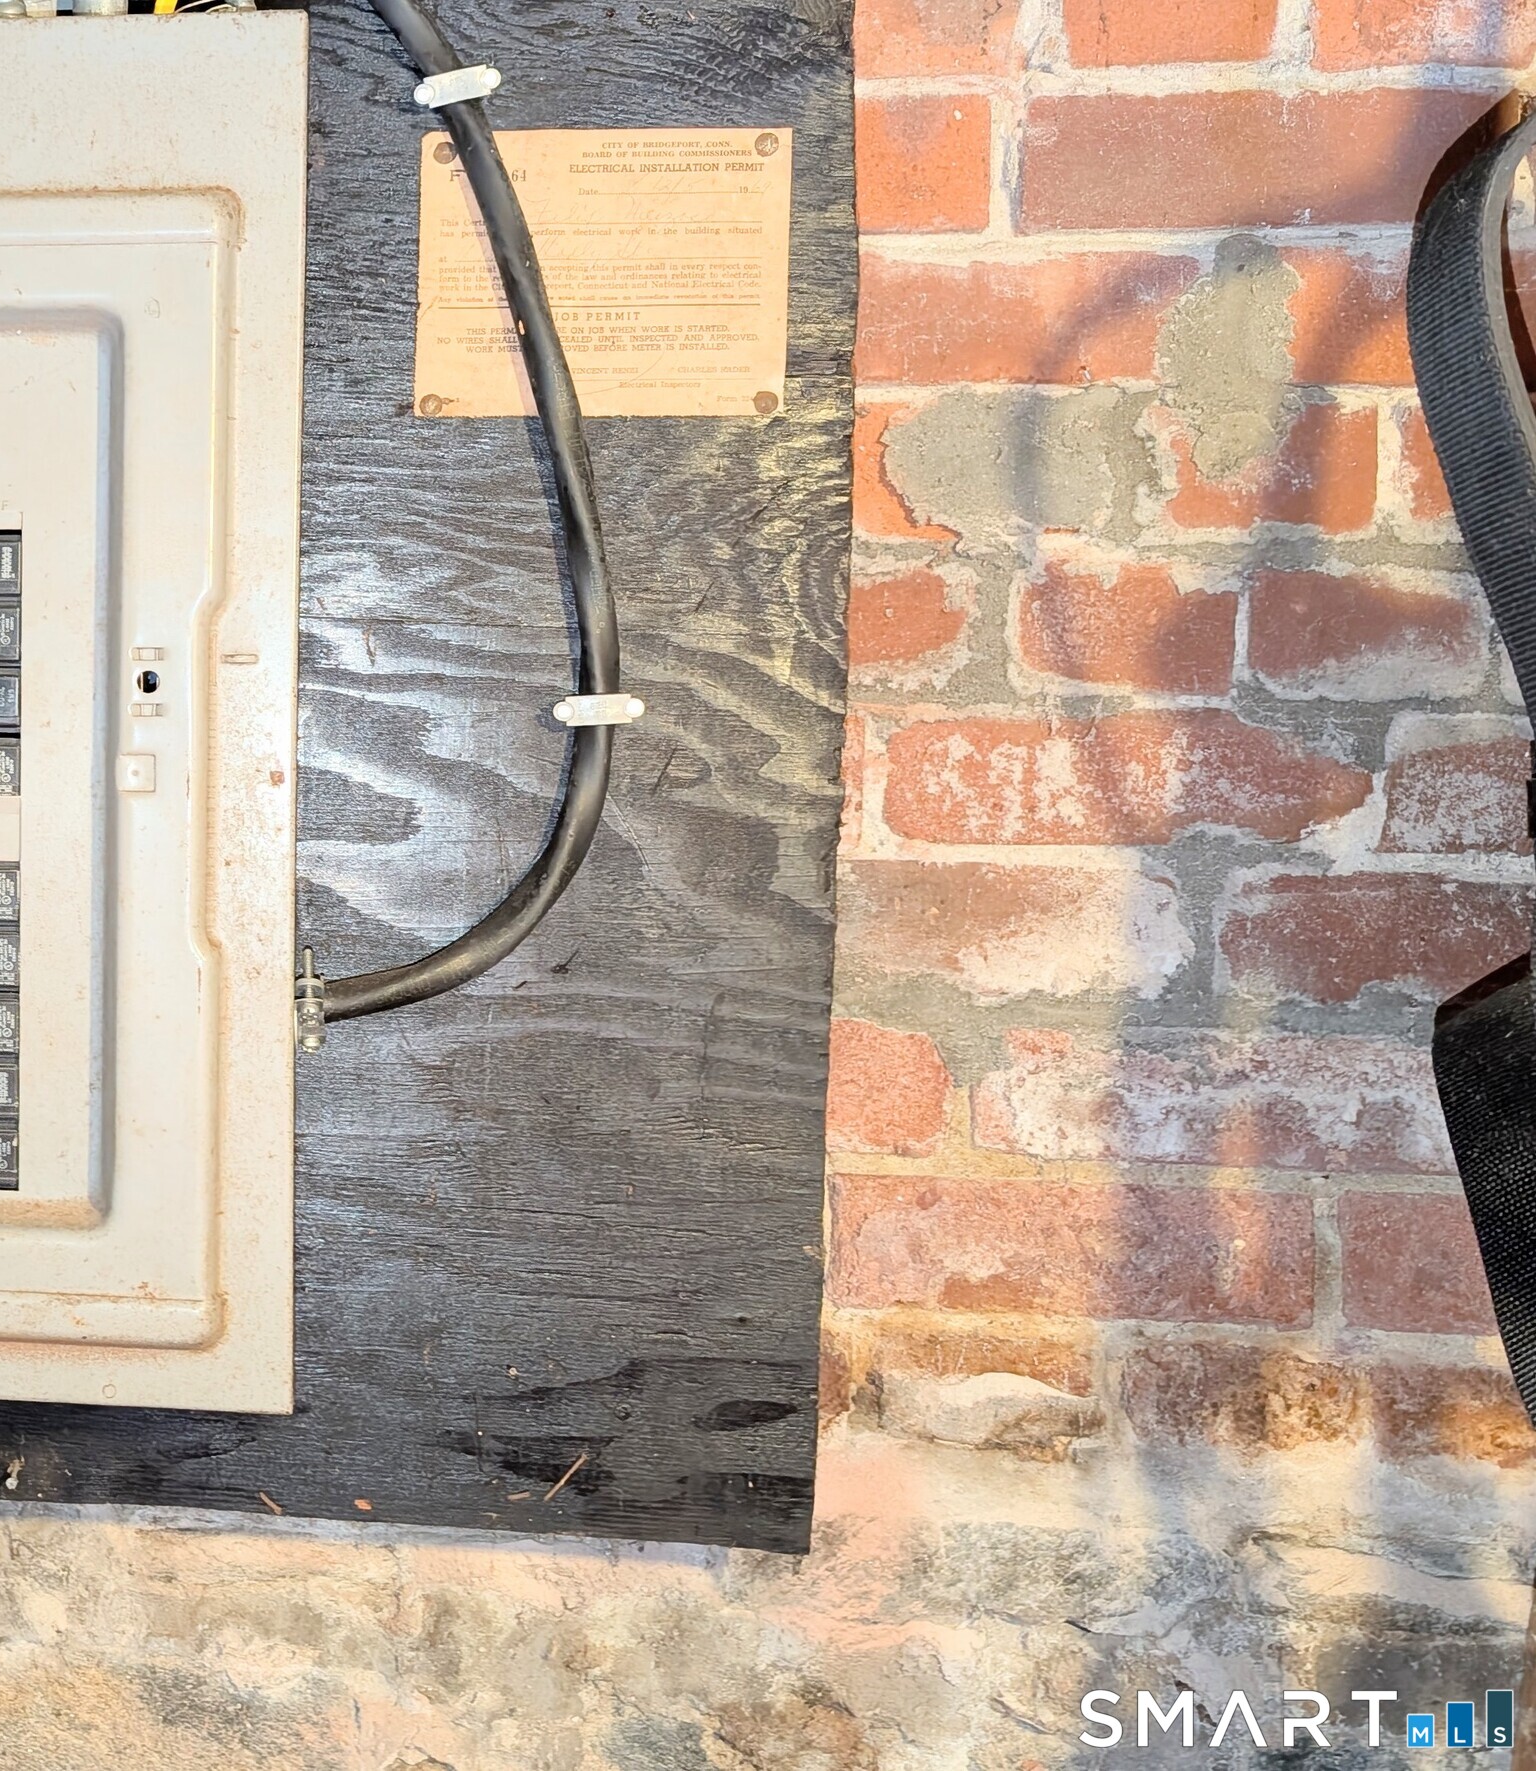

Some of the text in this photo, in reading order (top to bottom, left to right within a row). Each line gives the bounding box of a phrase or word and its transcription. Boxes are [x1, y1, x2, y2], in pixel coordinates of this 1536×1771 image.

[643, 141, 702, 149] BRIDGEPORT,
[569, 162, 764, 173] ELECTRICAL INSTALLATION PERMIT
[511, 169, 526, 182] 64
[573, 227, 611, 236] electrical
[685, 226, 720, 235] building
[728, 226, 762, 234] situated
[439, 265, 475, 274] provided
[549, 265, 589, 273] accepting
[613, 263, 641, 272] permit
[620, 272, 666, 280] ordinances
[671, 272, 706, 280] relating
[577, 281, 628, 290] Connecticut
[555, 312, 640, 321] JOB PERMIT
[642, 325, 670, 333] WORK
[489, 336, 517, 344] SHALL
[630, 334, 678, 342] INSPECTED
[666, 343, 674, 351] IS
[679, 343, 730, 351] INSTALLED.
